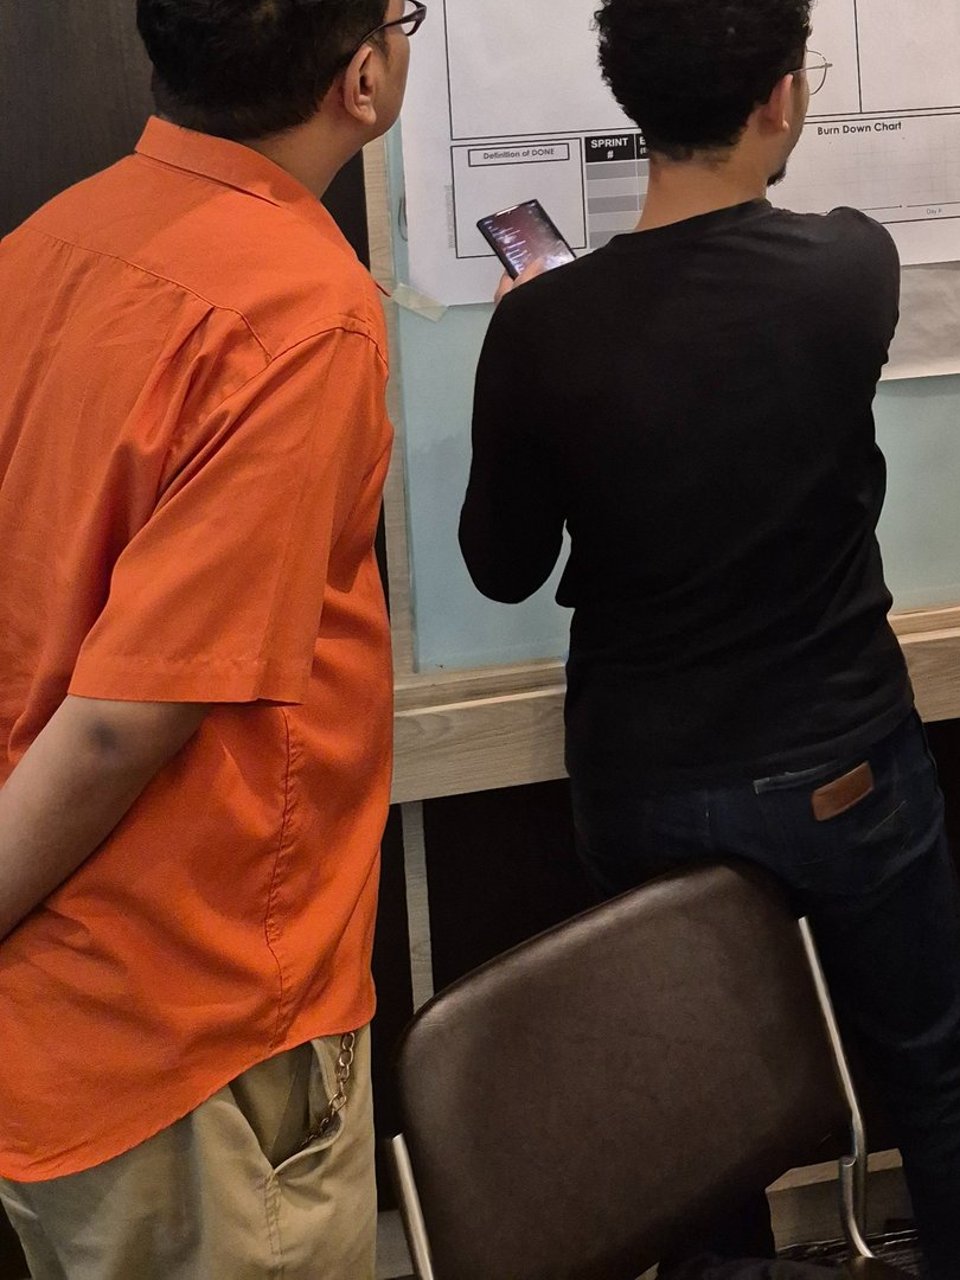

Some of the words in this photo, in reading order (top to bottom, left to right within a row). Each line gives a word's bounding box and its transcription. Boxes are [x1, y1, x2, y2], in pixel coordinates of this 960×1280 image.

[817, 125, 840, 136] Burn
[842, 123, 872, 134] Down
[874, 121, 902, 132] Chart
[591, 137, 629, 149] SPRINT
[531, 148, 554, 156] DONE
